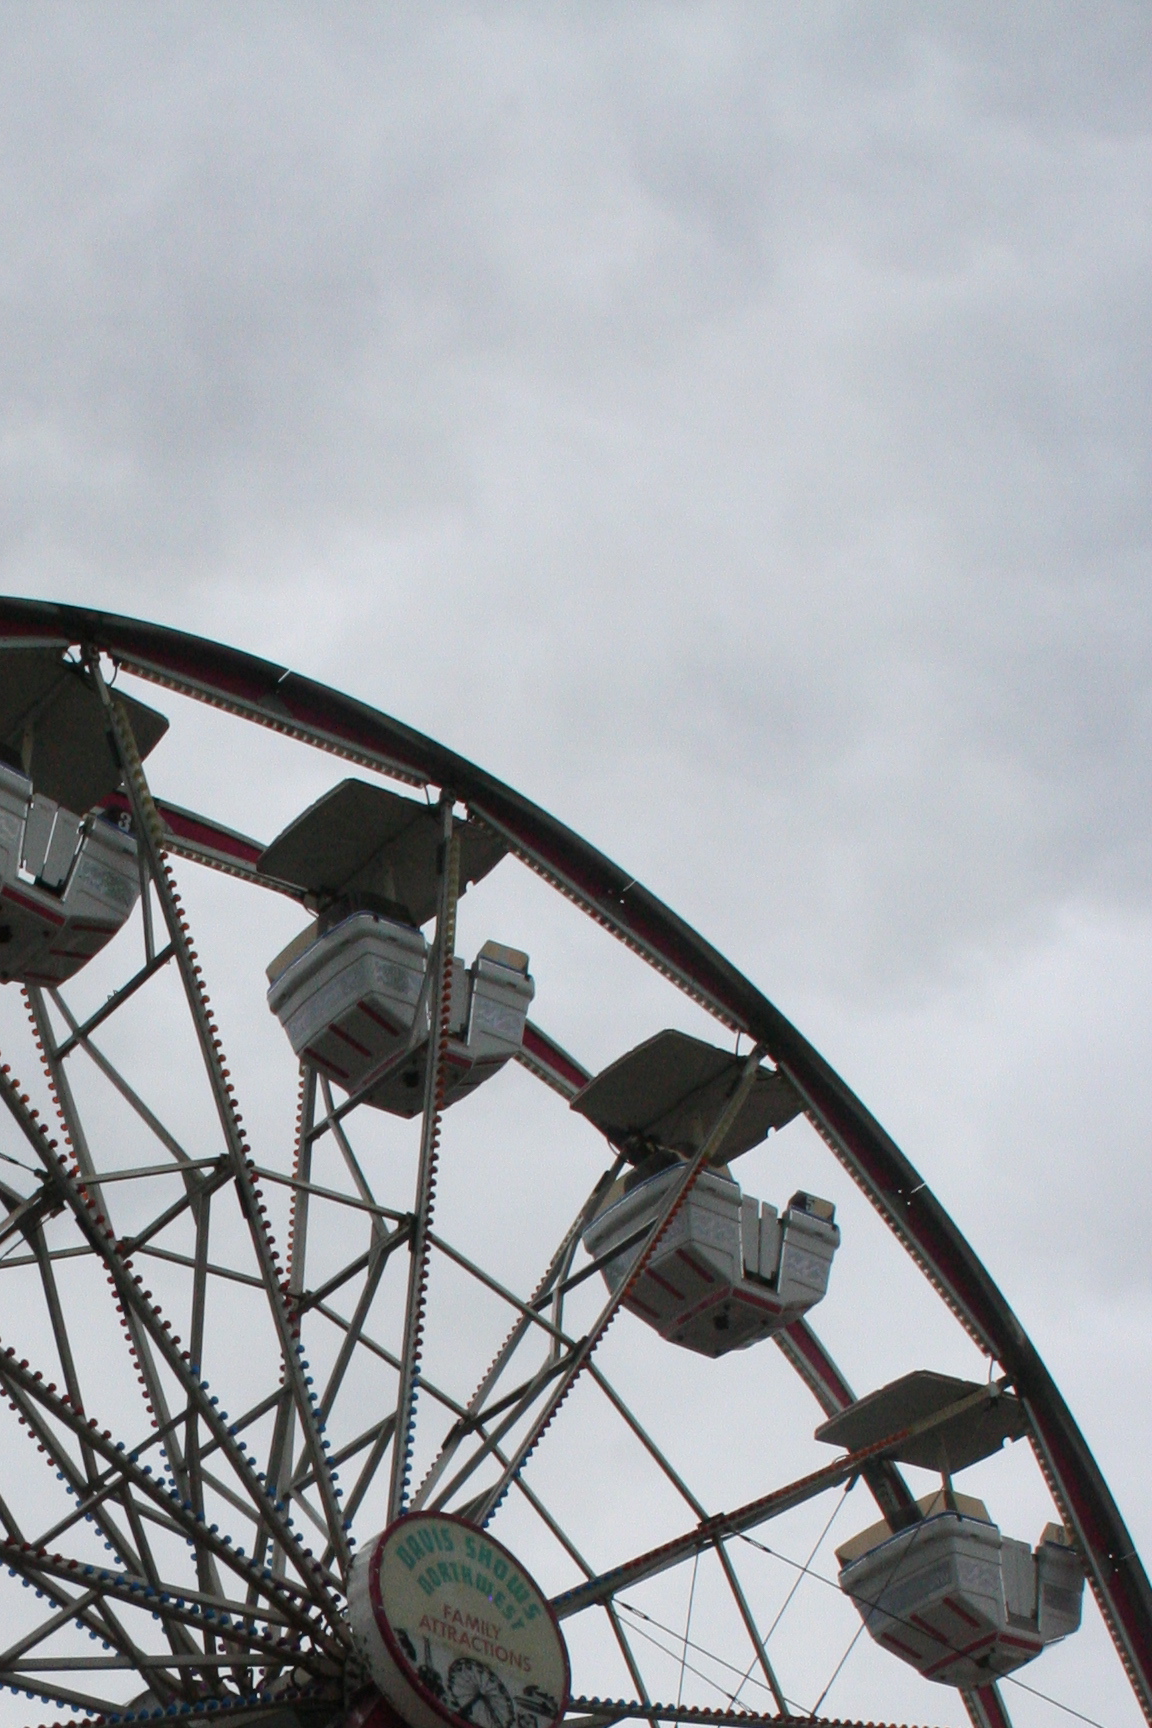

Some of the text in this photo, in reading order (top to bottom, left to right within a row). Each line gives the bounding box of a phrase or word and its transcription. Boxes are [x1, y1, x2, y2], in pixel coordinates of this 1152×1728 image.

[119, 811, 133, 832] 3
[396, 1527, 543, 1621] DAVIS SHOWS
[417, 1561, 525, 1631] NORTHWEST
[419, 1613, 532, 1673] ATTRACTIONS
[443, 1604, 503, 1640] FAMILY
